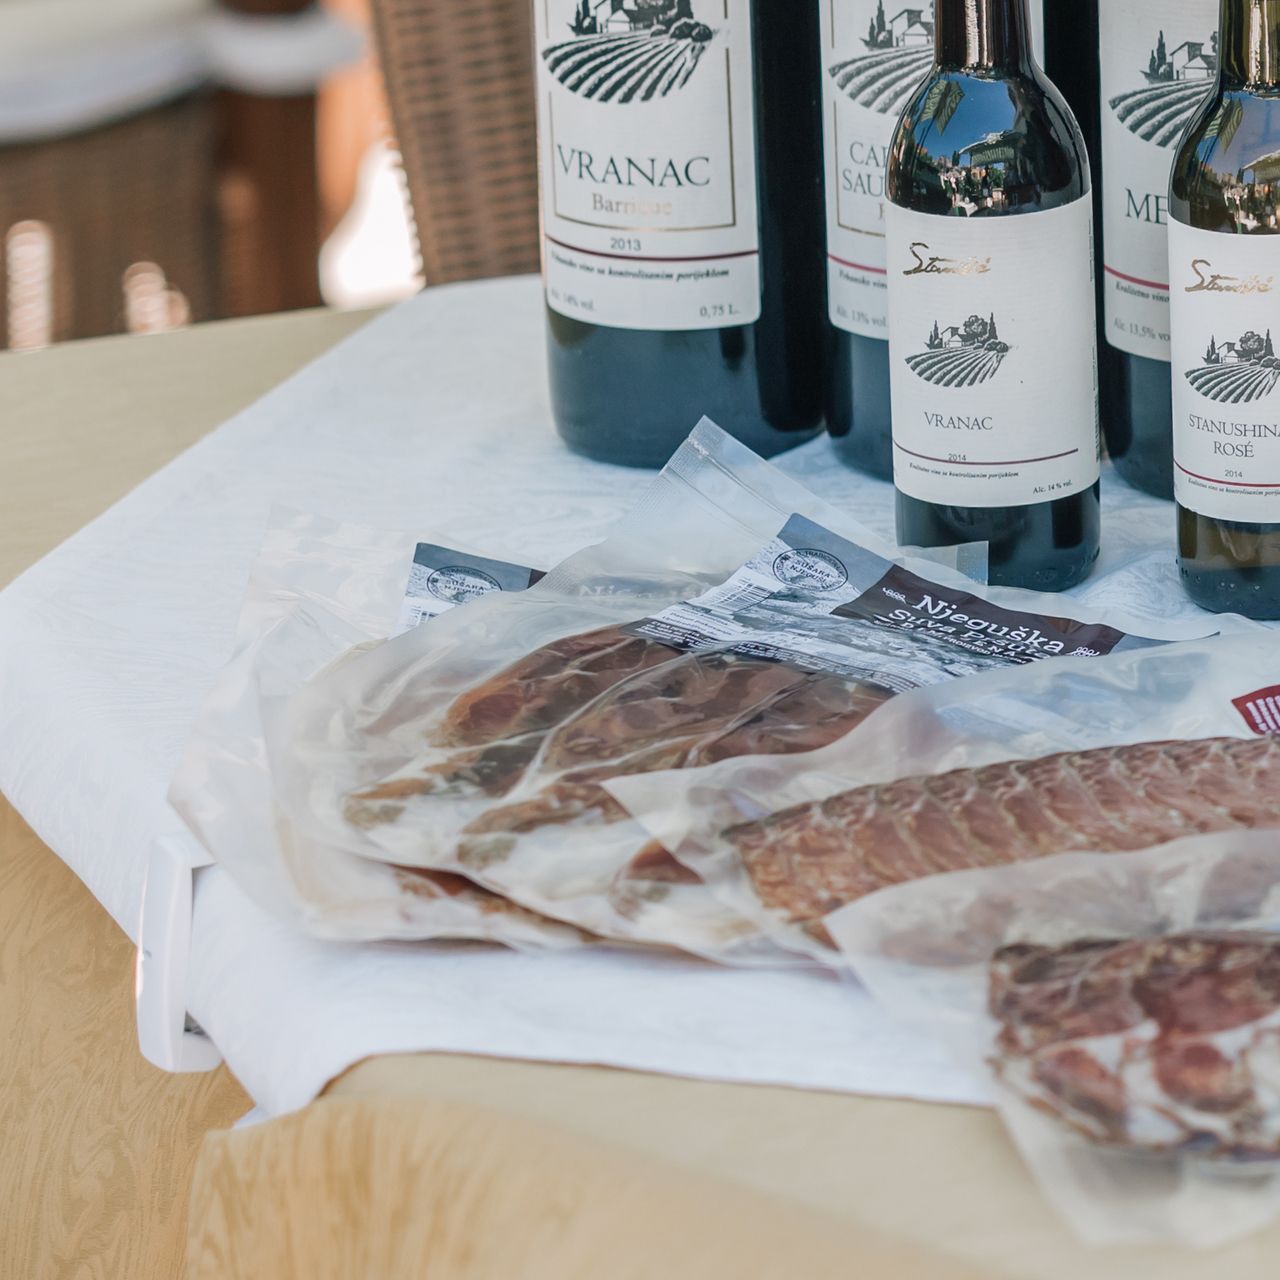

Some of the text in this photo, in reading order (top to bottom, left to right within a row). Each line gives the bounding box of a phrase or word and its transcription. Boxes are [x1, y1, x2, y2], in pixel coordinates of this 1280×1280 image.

[557, 144, 711, 187] VRANAC
[610, 237, 642, 251] 2013
[609, 266, 673, 280] kontrolisanim
[676, 269, 729, 282] porijeklom
[700, 306, 725, 317] 0,75
[924, 412, 994, 431] VRANAC
[948, 453, 967, 462] 2014
[1213, 441, 1255, 458] ROSÉ
[1224, 469, 1243, 478] 2014
[1032, 487, 1046, 495] Alc.
[888, 609, 957, 633] Suva
[912, 595, 1064, 654] Njeguška
